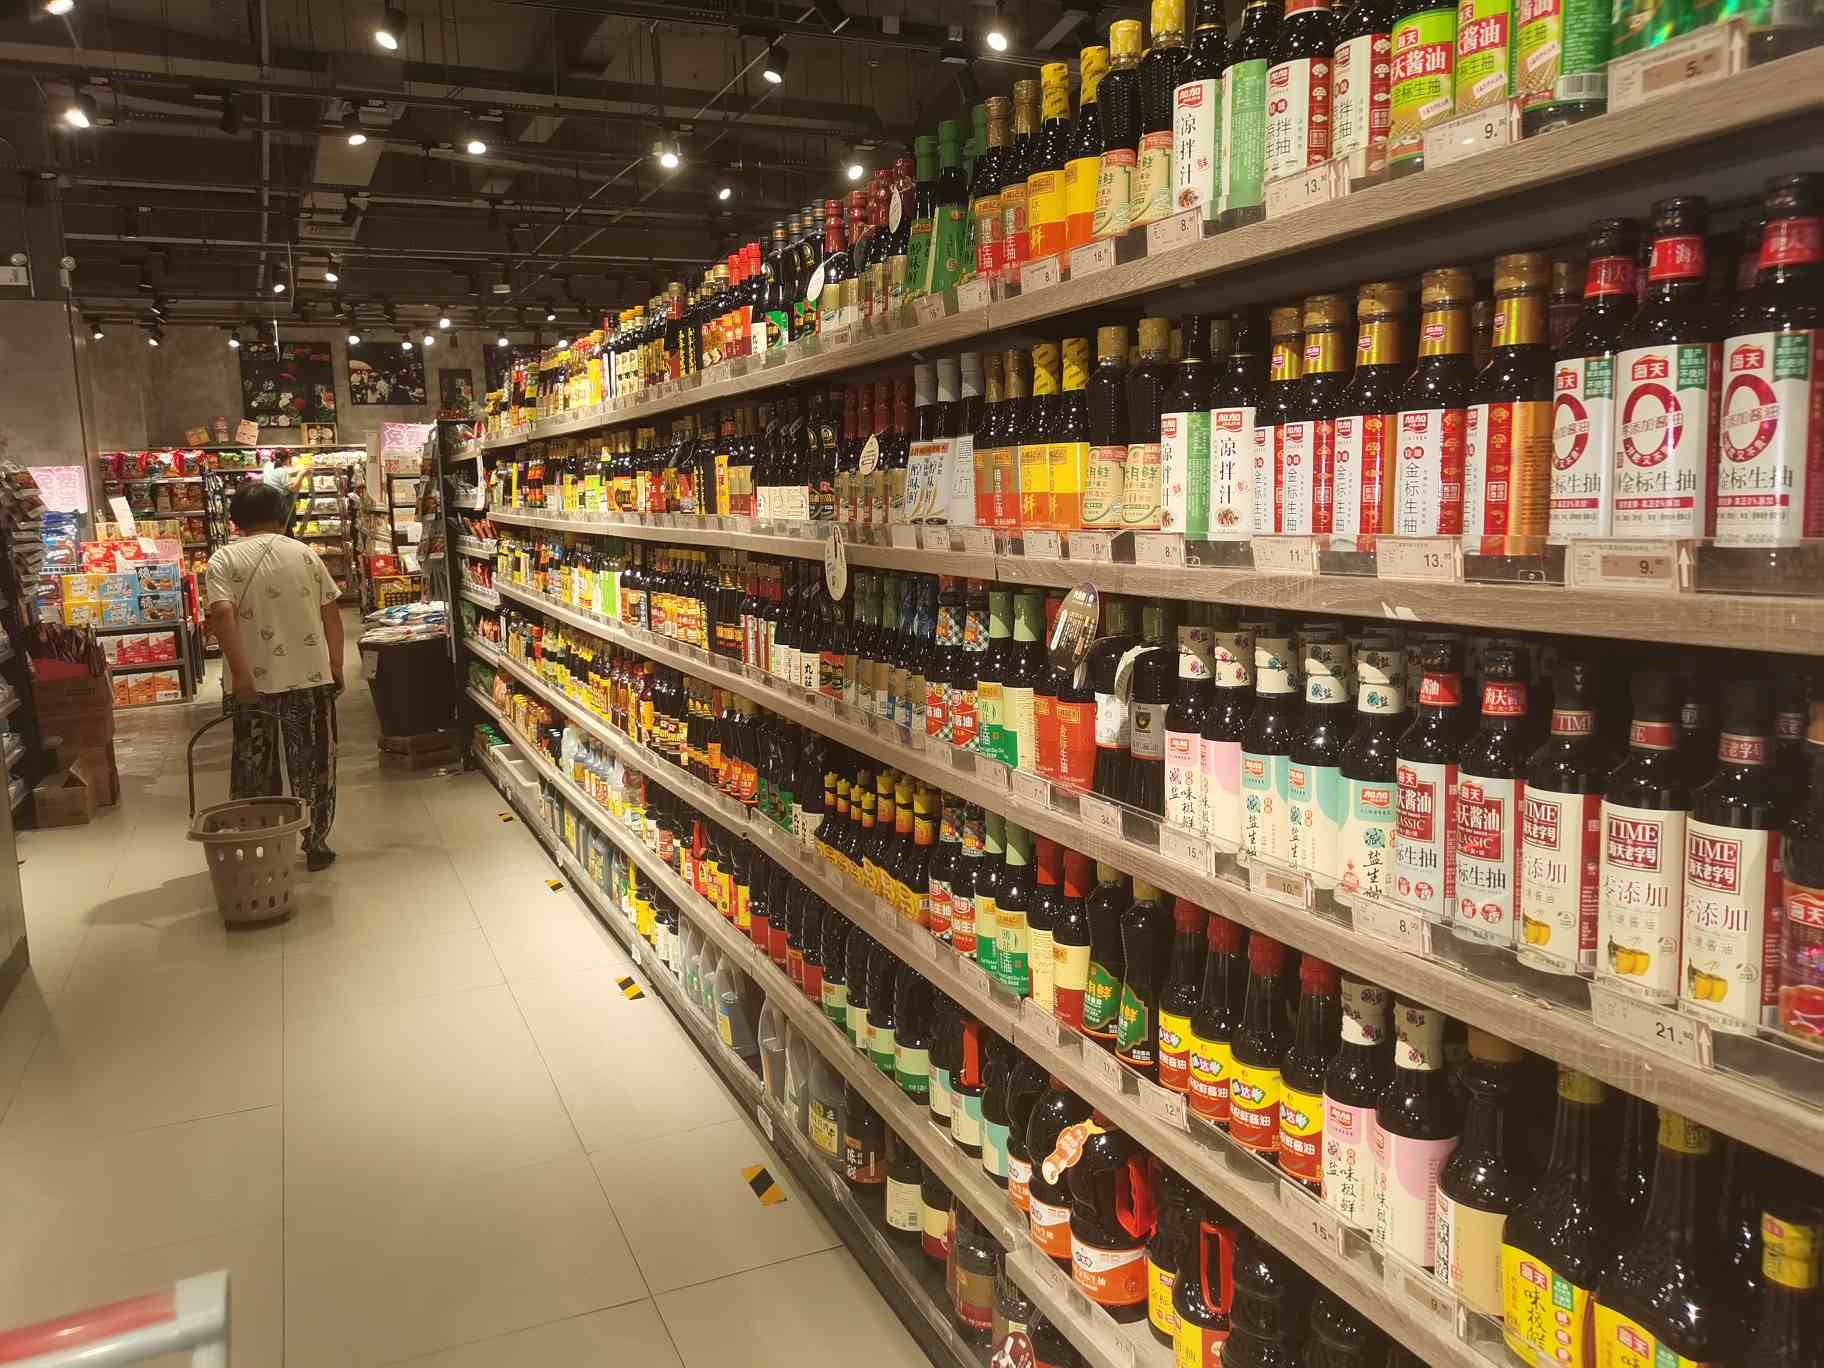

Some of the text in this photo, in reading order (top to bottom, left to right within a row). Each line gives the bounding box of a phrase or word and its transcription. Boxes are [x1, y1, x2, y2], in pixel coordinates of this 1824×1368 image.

[1391, 47, 1446, 81] 天酱油
[1180, 113, 1197, 186] 凉拌汁
[1634, 363, 1667, 379] 海天
[1732, 352, 1763, 369] 海天
[1219, 437, 1237, 505] 凉拌汁
[1403, 462, 1419, 534] 金标生抽
[1397, 814, 1425, 831] ASSIC
[1608, 818, 1659, 846] TIME
[1688, 837, 1738, 864] TIME
